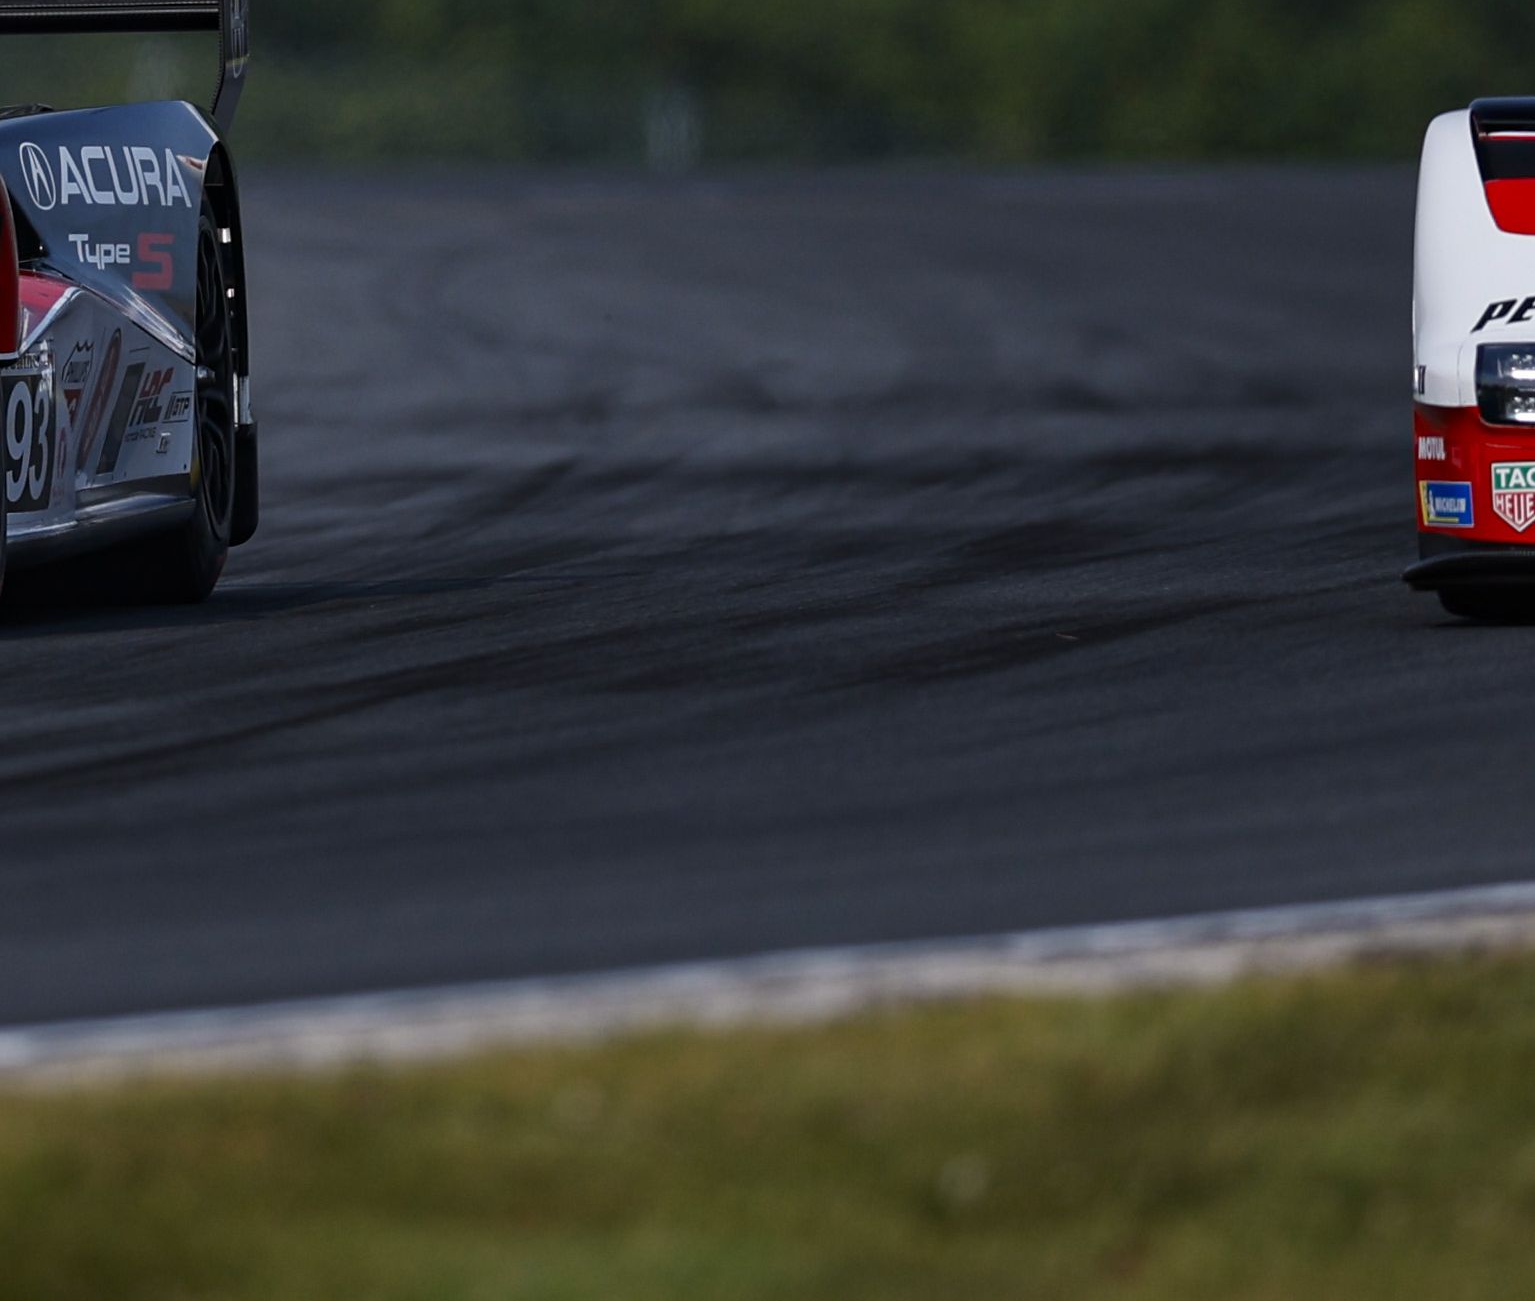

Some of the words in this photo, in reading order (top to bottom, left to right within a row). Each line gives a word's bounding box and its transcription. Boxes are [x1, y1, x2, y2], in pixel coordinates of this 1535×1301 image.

[58, 145, 193, 209] ACURA
[68, 233, 131, 271] Type
[131, 231, 177, 290] S
[5, 380, 50, 502] 93
[1418, 437, 1446, 461] MOTUL
